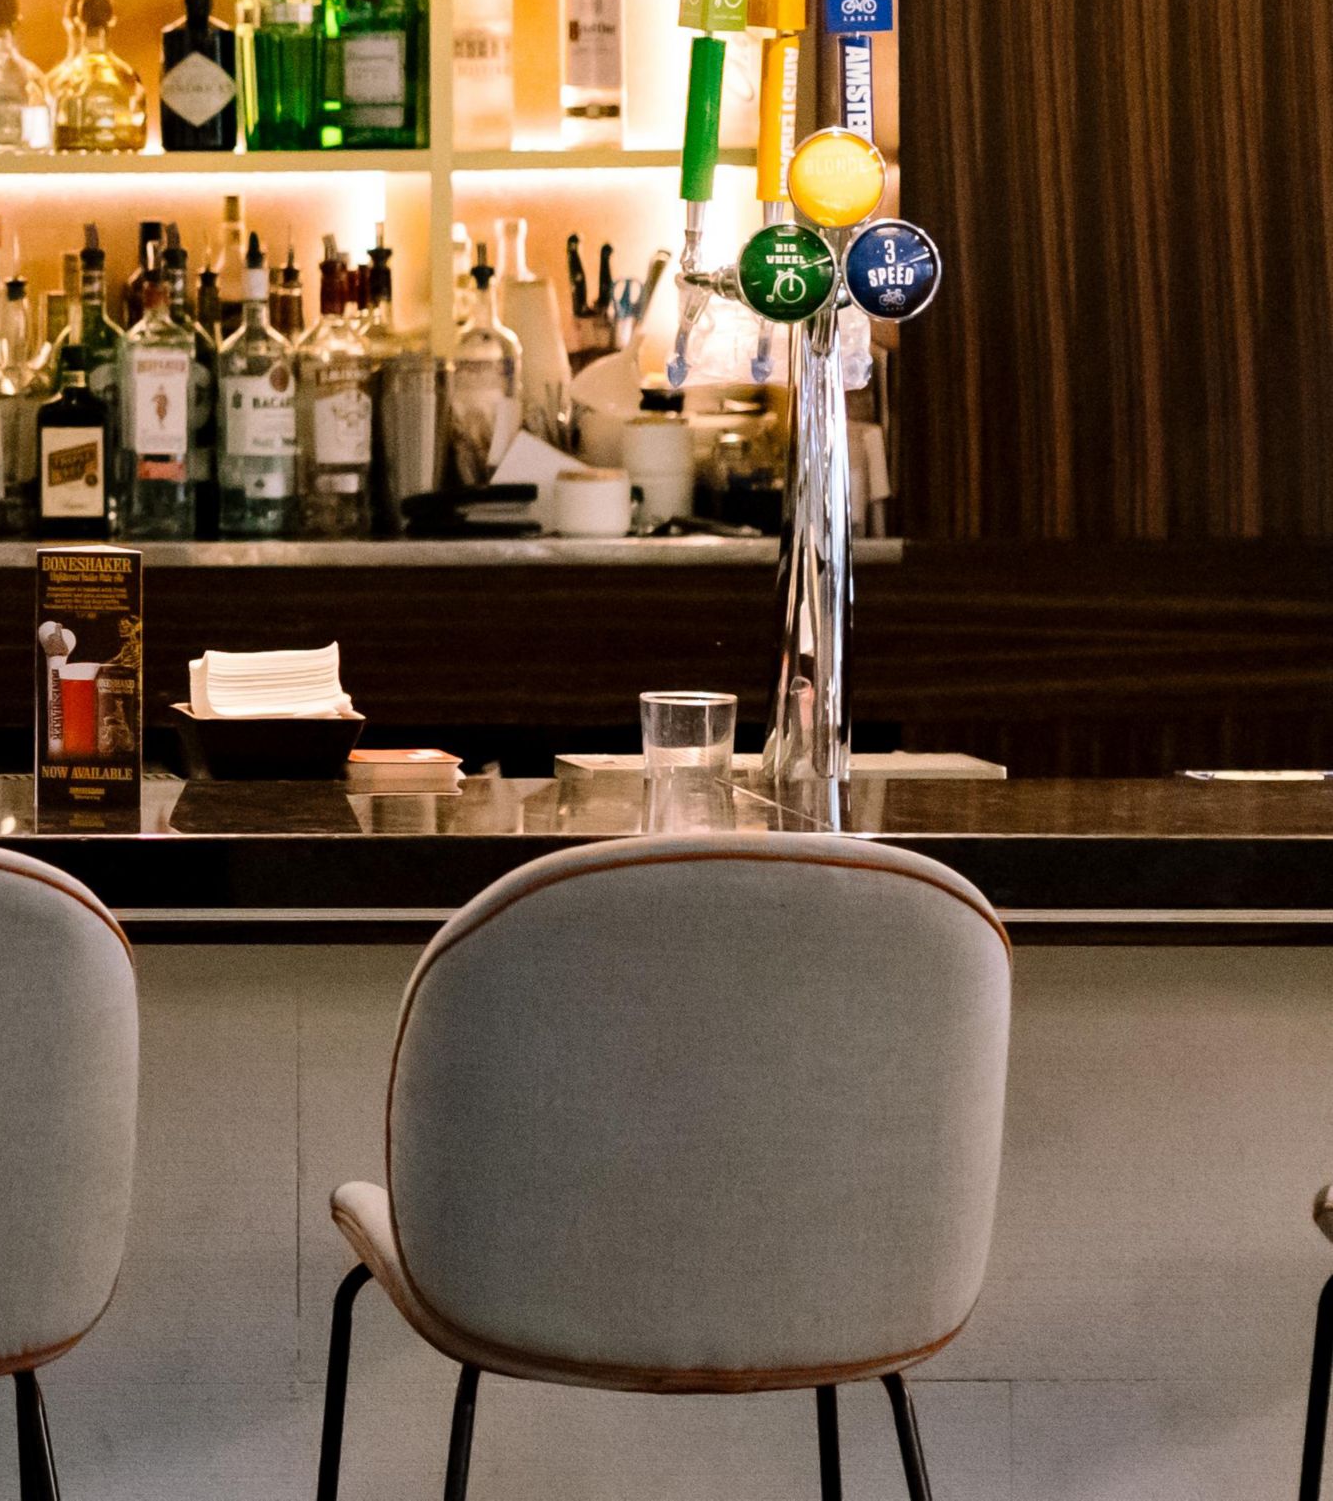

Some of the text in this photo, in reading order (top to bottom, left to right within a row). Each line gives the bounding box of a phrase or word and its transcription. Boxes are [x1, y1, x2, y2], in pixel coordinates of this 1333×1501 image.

[775, 243, 797, 253] BIG
[884, 239, 896, 265] 3
[766, 255, 806, 264] WHEEL
[868, 267, 915, 288] SPEED
[42, 556, 132, 573] BONESHAKER
[41, 766, 133, 780] NOW AVAILABLE
